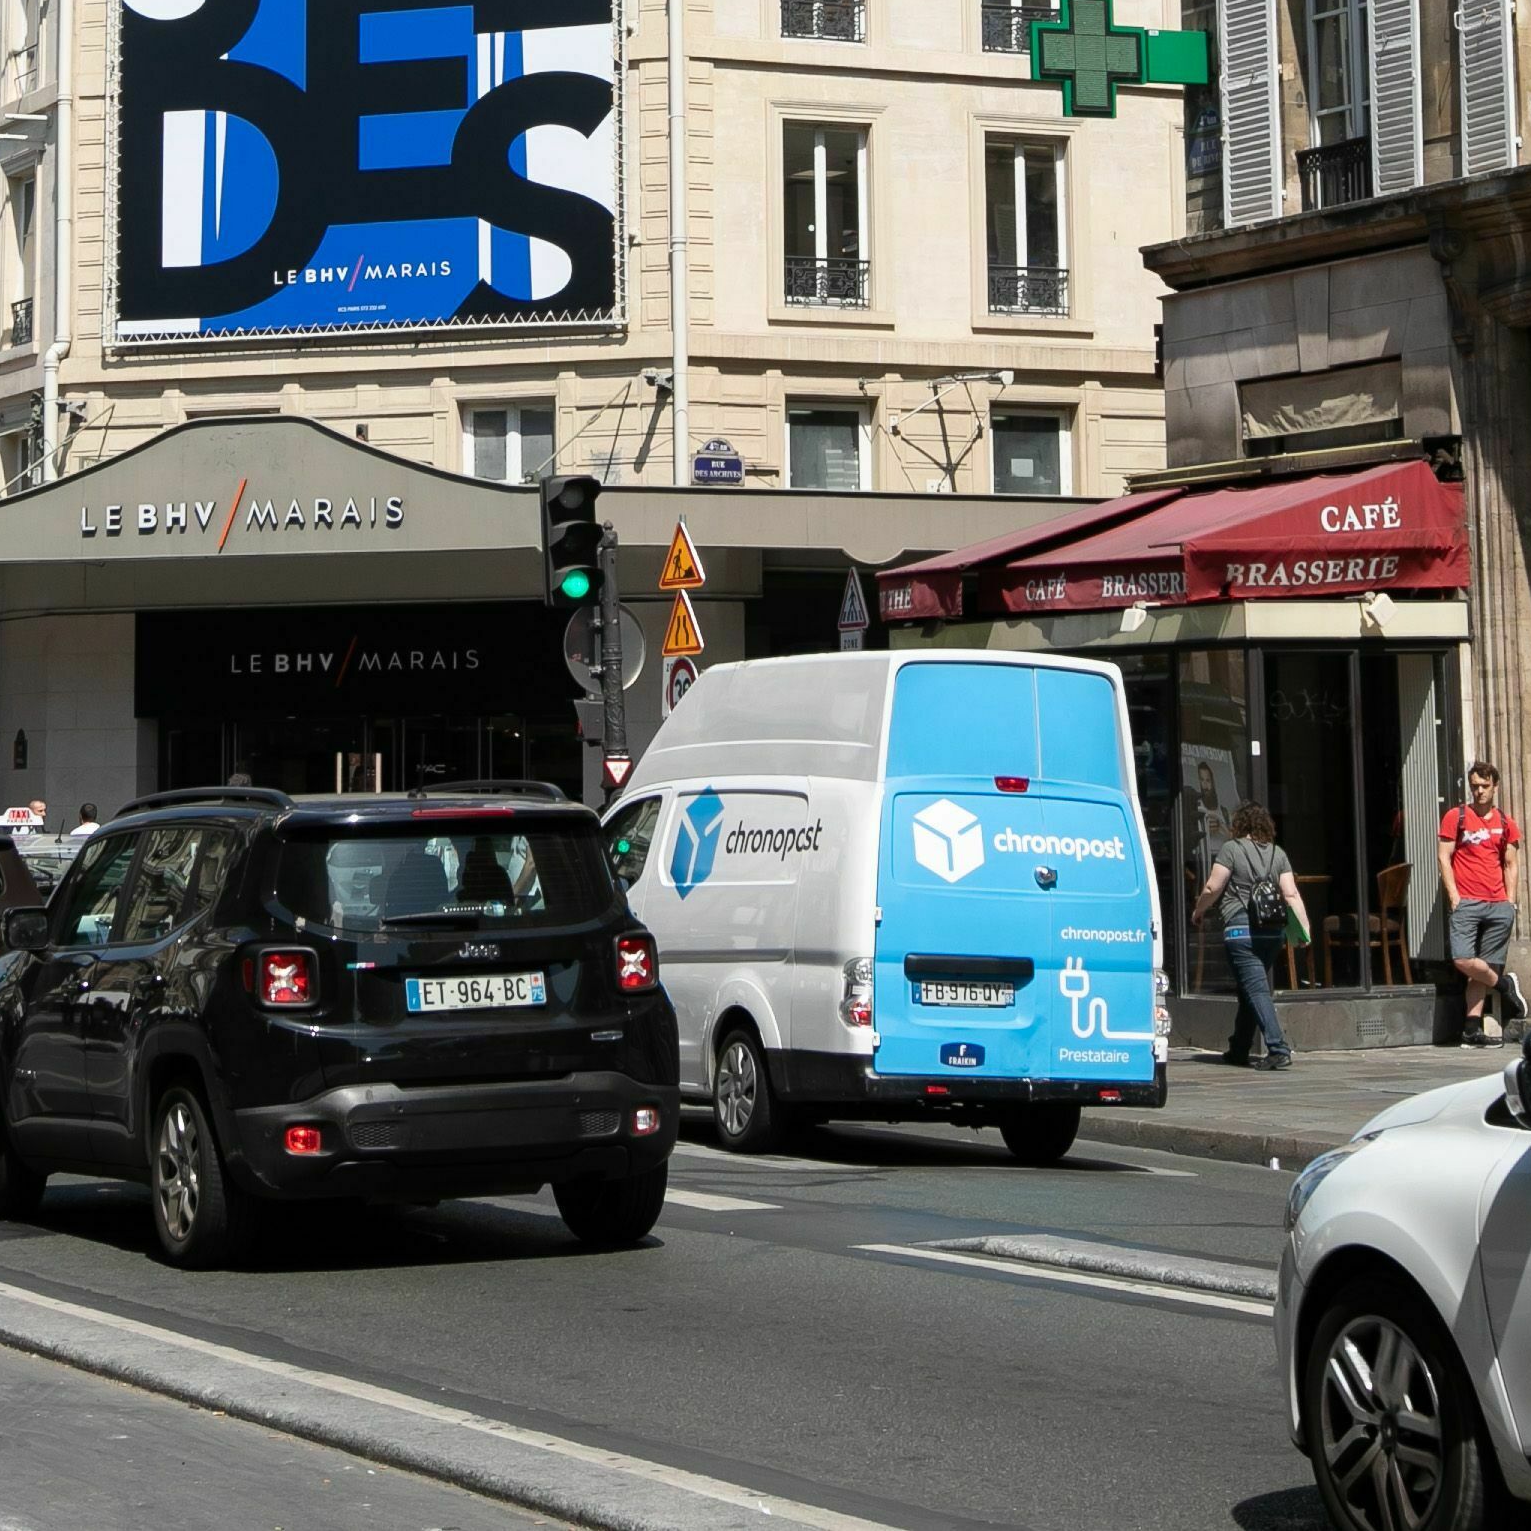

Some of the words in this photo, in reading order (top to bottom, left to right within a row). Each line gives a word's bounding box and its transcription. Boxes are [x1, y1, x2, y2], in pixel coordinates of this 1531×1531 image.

[273, 270, 297, 285] LE
[305, 267, 348, 283] BHV
[364, 261, 451, 280] MARAIS
[709, 470, 742, 478] ARCHIVES
[81, 506, 123, 536] LE
[138, 501, 216, 532] BHV
[246, 497, 403, 530] MARAIS
[1320, 497, 1401, 532] CAFÉ
[1226, 555, 1400, 587] BRASSERIE
[888, 585, 912, 610] THÉ
[1025, 573, 1067, 601] CAFÉ
[1102, 572, 1187, 598] BRASSERI
[843, 639, 858, 649] ZONE
[231, 654, 262, 673] LE
[274, 653, 334, 672] BHV
[358, 649, 480, 671] MARAIS
[9, 809, 30, 819] TAXI
[994, 827, 1125, 861] chronopost
[1060, 926, 1147, 943] chronopost.fr
[532, 988, 544, 1001] 75
[949, 1056, 977, 1066] FRAIKIN
[1059, 1048, 1130, 1063] Prestataire
